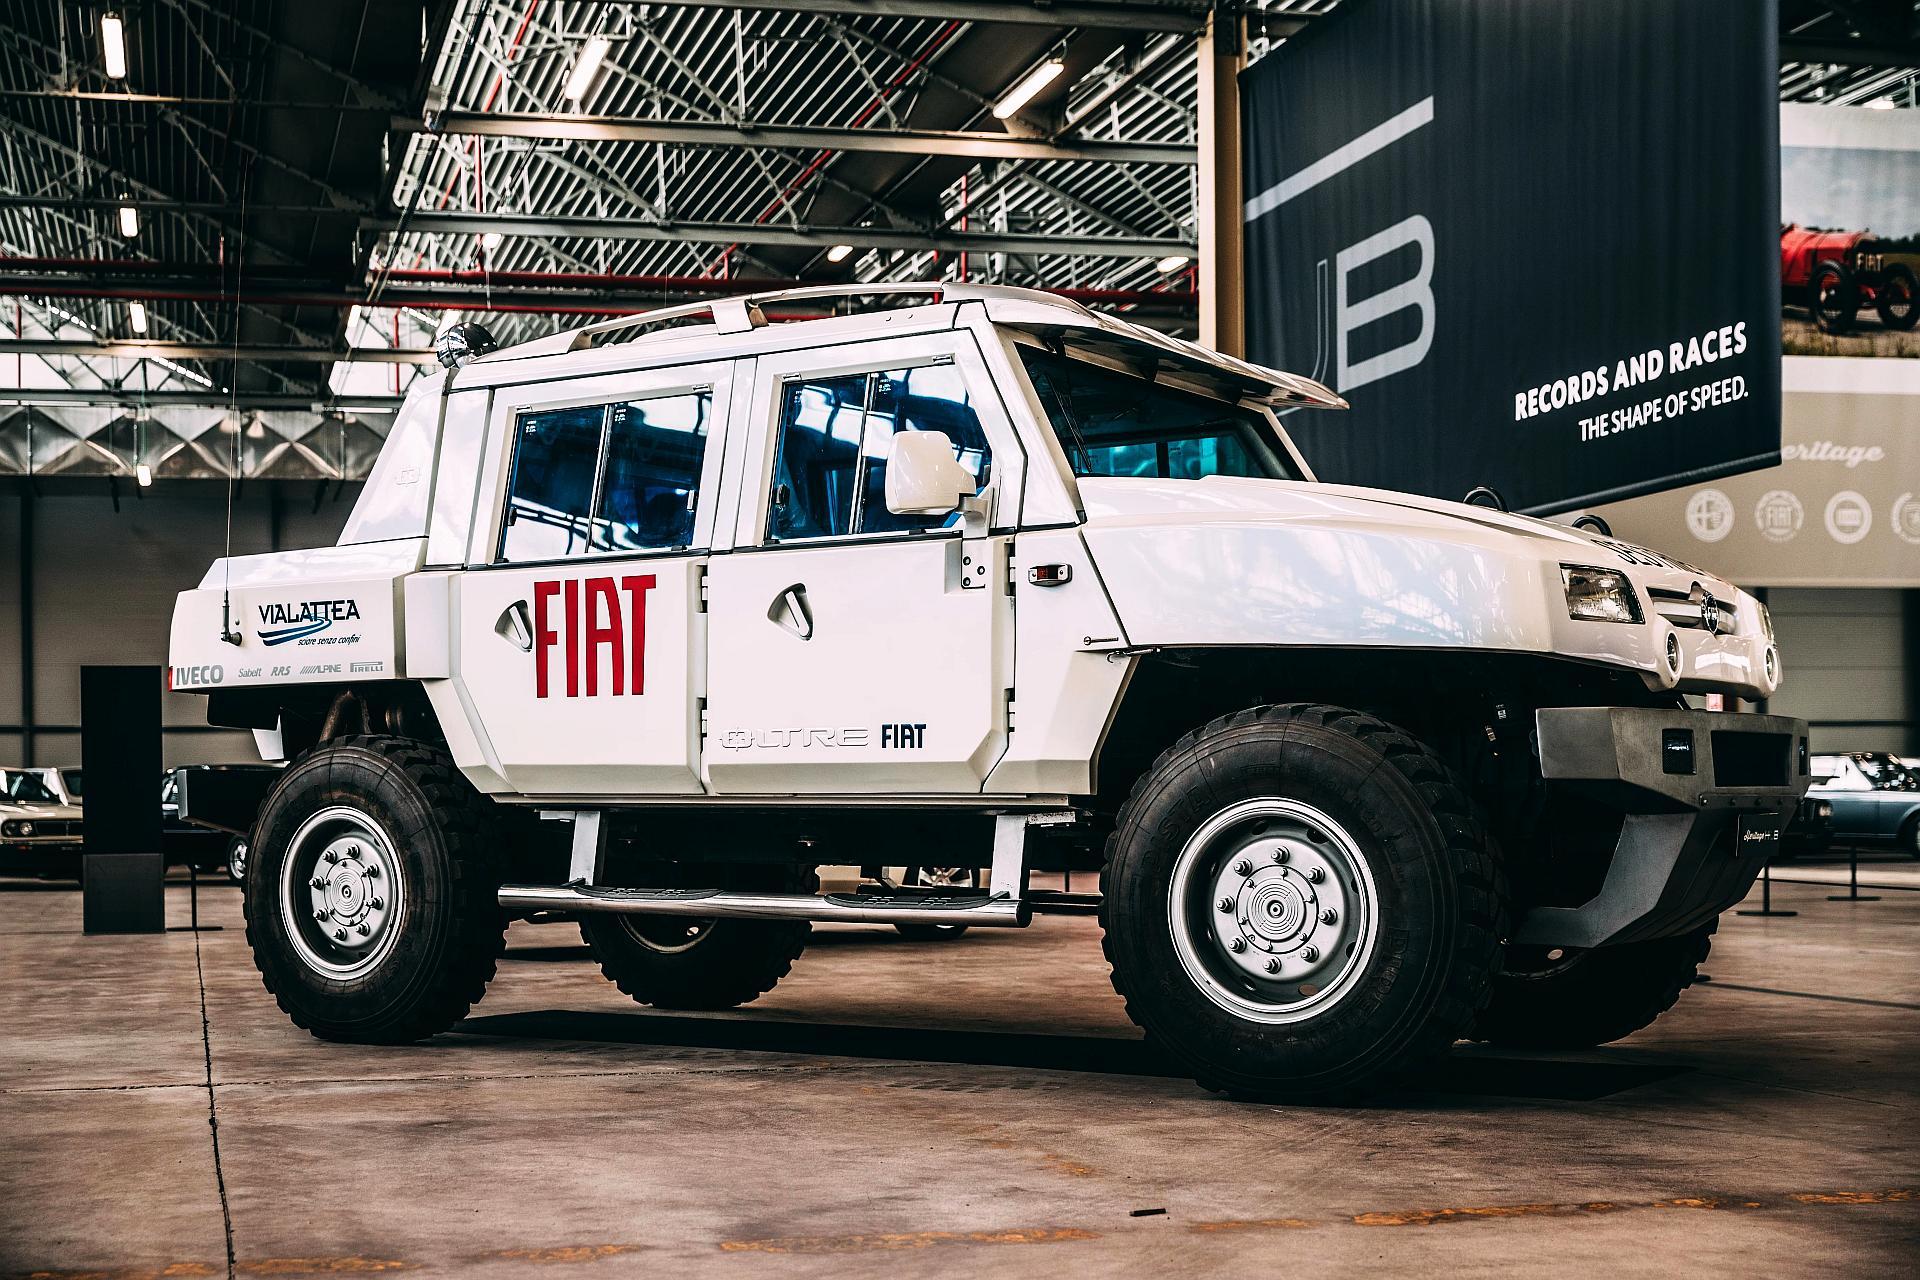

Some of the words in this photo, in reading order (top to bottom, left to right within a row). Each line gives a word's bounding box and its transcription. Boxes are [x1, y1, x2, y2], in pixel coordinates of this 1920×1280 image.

[1514, 366, 1609, 421] RECORDS
[1613, 349, 1664, 391] AND
[1669, 321, 1747, 372] RACES
[1578, 413, 1610, 442] THE
[1611, 398, 1663, 434] SHAPE
[1664, 390, 1688, 418] OF
[1690, 376, 1749, 412] SPEED.
[1781, 441, 1885, 468] eritage
[258, 599, 361, 625] VIALATTEA
[317, 636, 337, 645] senza
[338, 633, 362, 644] confini
[534, 574, 656, 698] FIAT
[176, 665, 224, 686] IVECO
[238, 667, 262, 678] Sabelt
[270, 666, 291, 677] RRS
[350, 661, 383, 673] PIRELLI
[881, 724, 926, 749] FIAT
